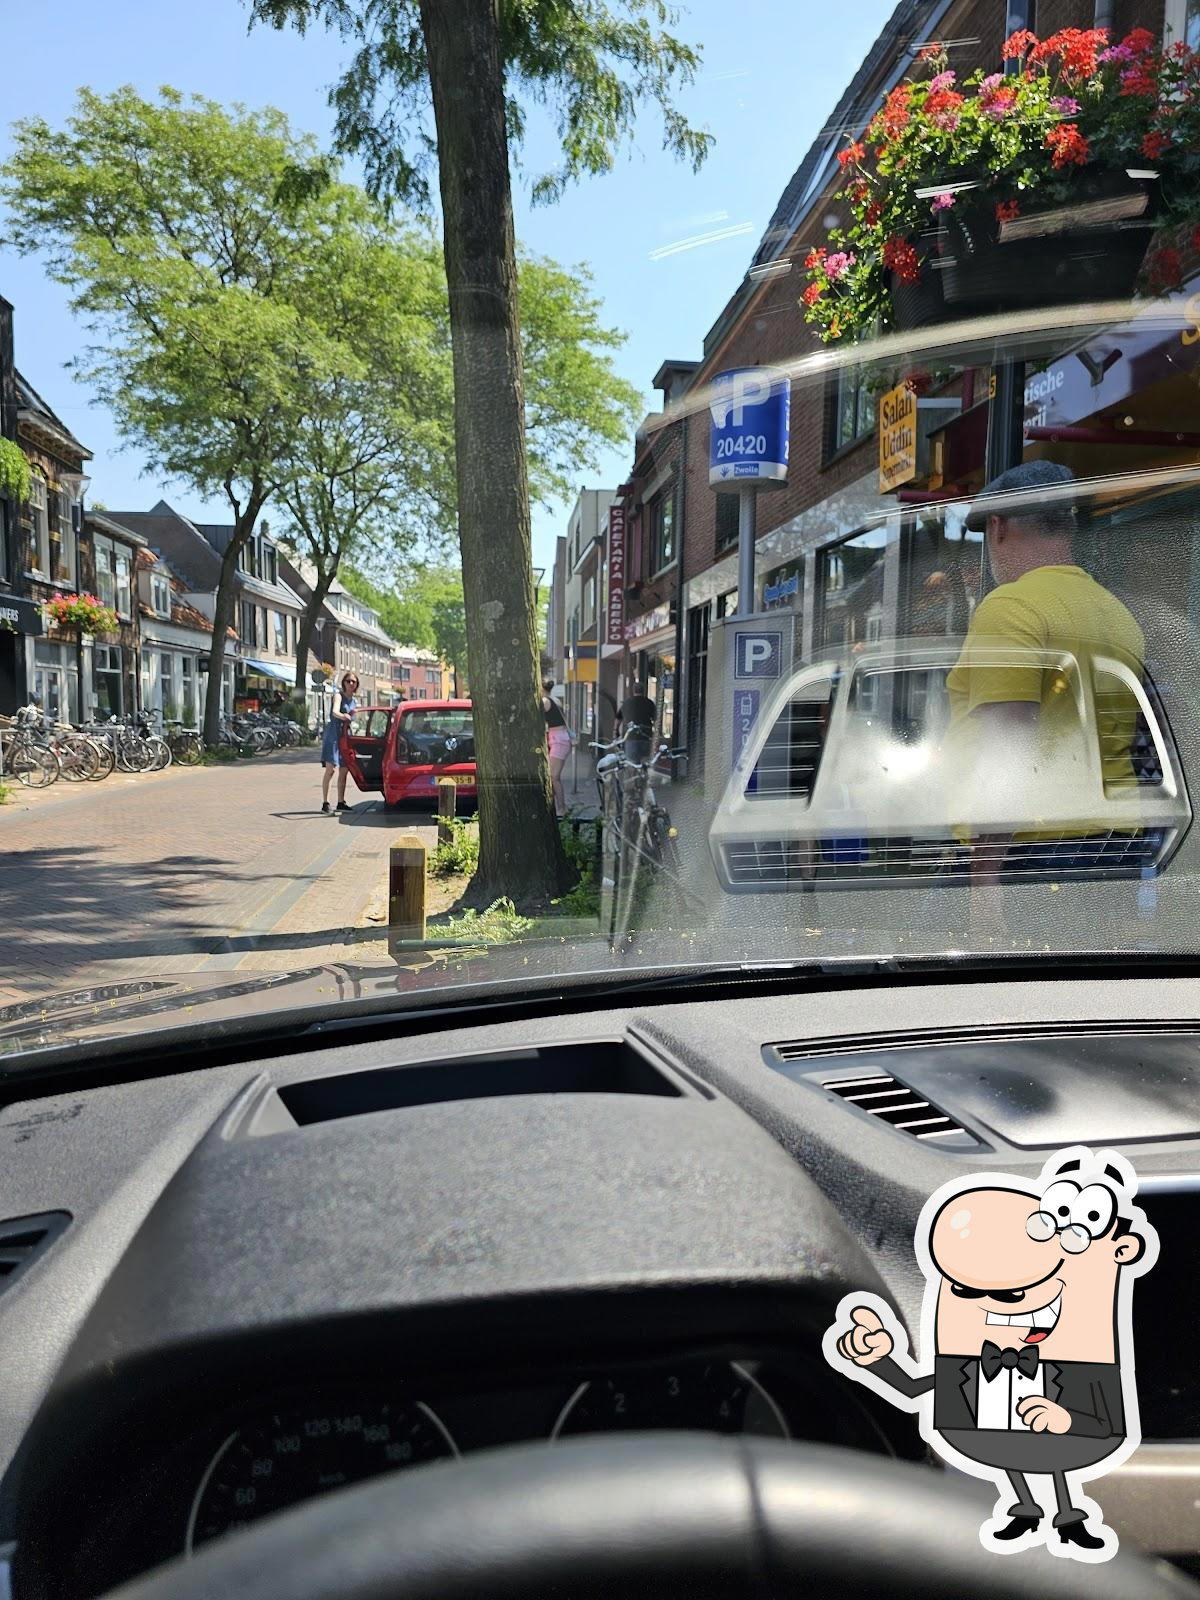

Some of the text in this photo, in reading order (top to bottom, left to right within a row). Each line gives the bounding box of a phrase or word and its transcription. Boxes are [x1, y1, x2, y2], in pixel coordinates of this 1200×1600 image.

[732, 371, 771, 427] P
[1024, 369, 1065, 406] tische
[717, 435, 767, 459] 20420
[882, 421, 908, 453] Uddin
[734, 464, 759, 476] Zwolle
[609, 509, 624, 641] CAFETARIA ALBERTO
[744, 639, 772, 673] P
